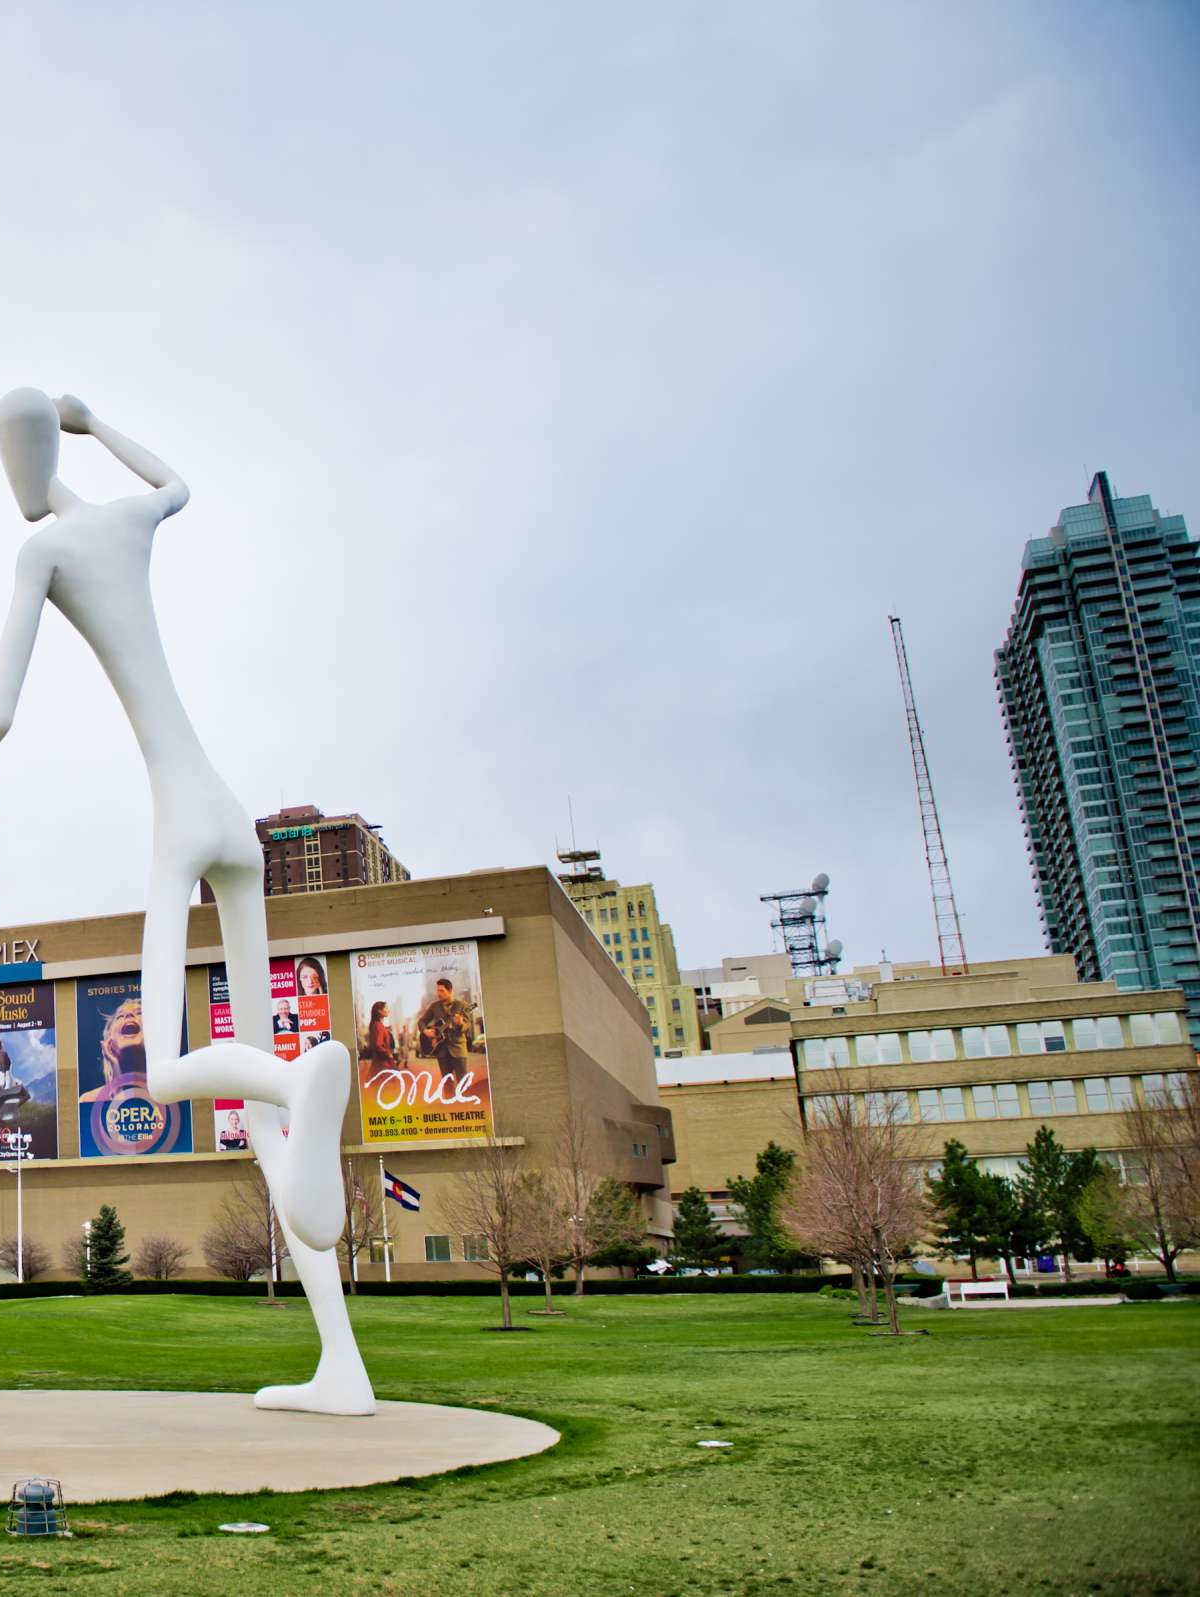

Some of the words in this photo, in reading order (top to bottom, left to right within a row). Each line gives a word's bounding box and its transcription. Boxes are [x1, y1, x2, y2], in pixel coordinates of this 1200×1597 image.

[357, 954, 367, 968] 8
[214, 1016, 232, 1025] MAST
[300, 1018, 317, 1026] POPS
[274, 1043, 297, 1051] FAMILY
[106, 1106, 163, 1123] OPERA
[368, 1116, 387, 1126] MAY
[423, 1112, 448, 1123] BUELL
[450, 1110, 486, 1121] THEATRE
